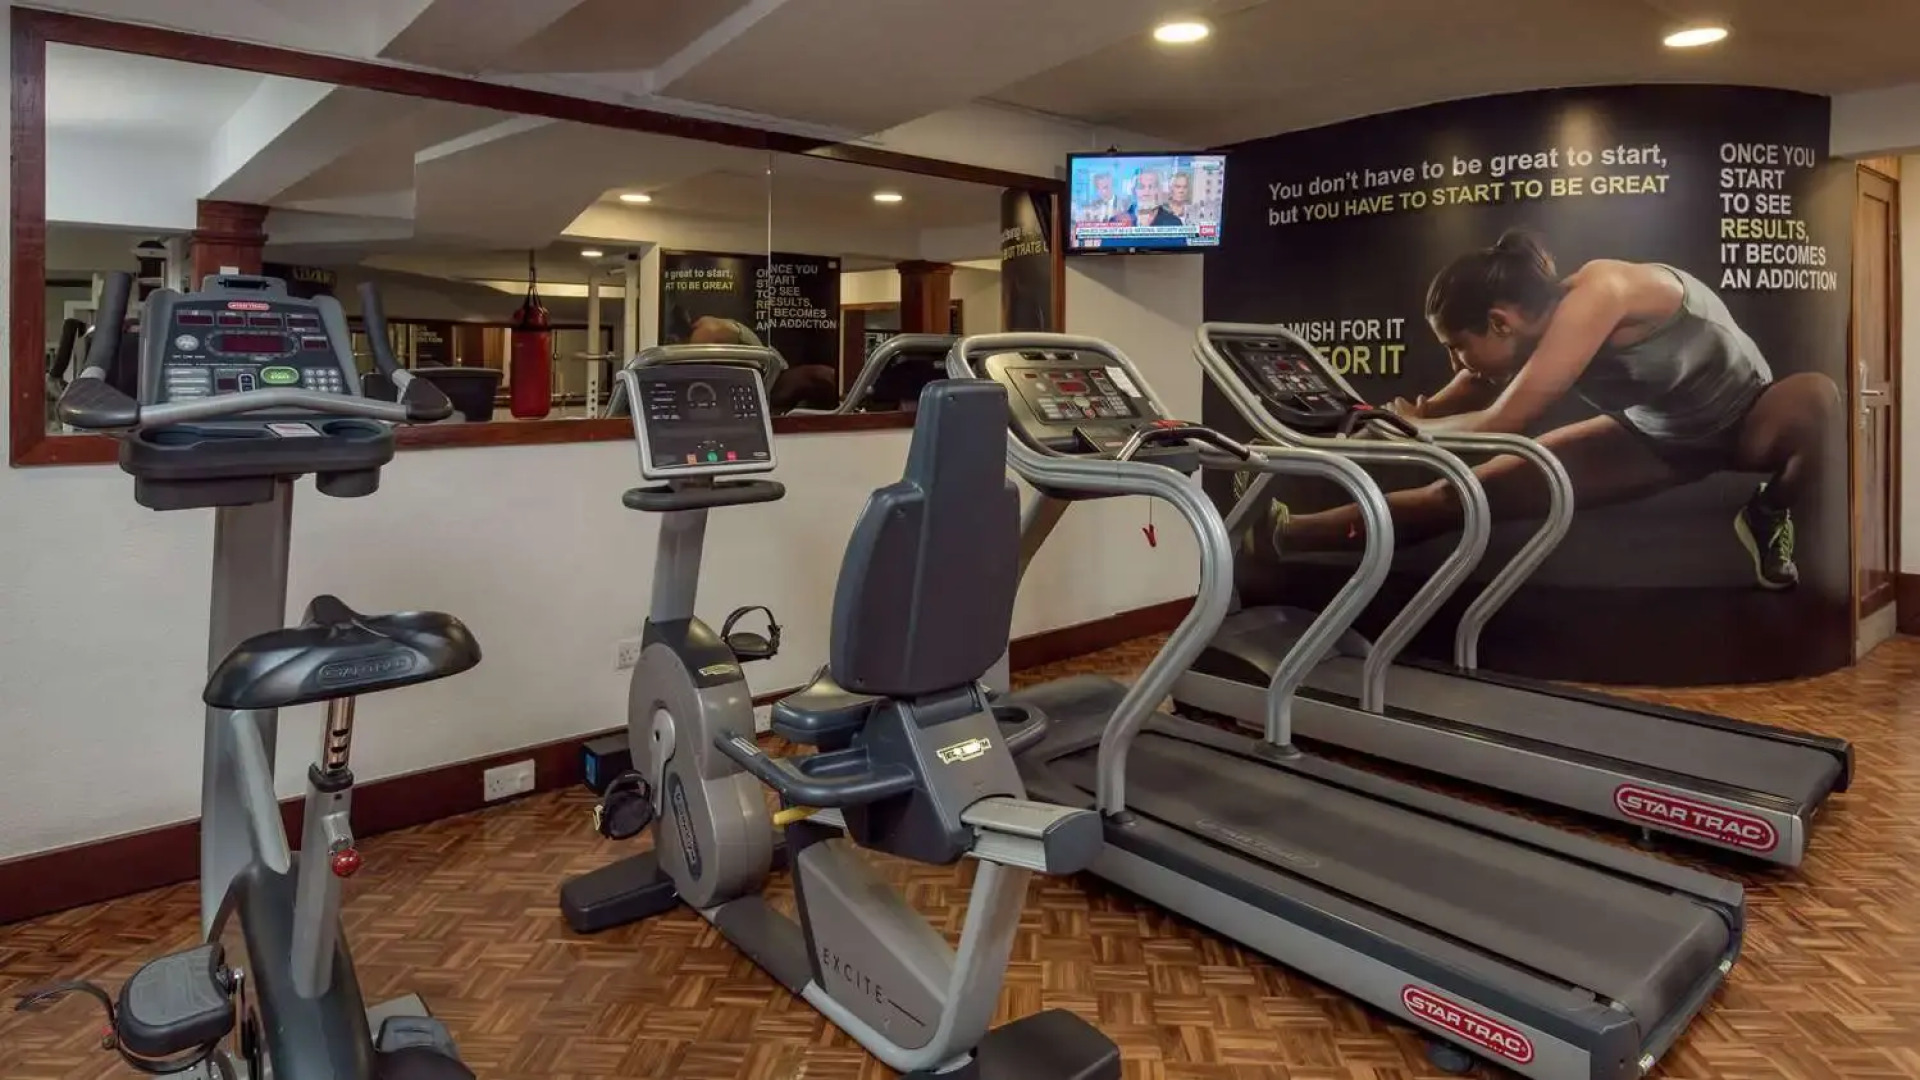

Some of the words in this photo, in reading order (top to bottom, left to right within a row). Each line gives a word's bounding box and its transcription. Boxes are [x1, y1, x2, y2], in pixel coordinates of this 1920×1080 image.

[1720, 143, 1778, 164] ONCE
[1783, 145, 1814, 168] YOU
[1269, 182, 1302, 200] You
[1309, 171, 1358, 195] don't
[1364, 167, 1414, 187] have
[1422, 161, 1445, 179] to
[1452, 155, 1482, 176] be
[1491, 147, 1558, 177] great
[1567, 146, 1592, 167] to
[1601, 144, 1667, 168] start,
[1720, 168, 1785, 190] START
[1269, 205, 1298, 226] but
[1303, 202, 1339, 221] YOU
[1345, 195, 1394, 216] HAVE
[1399, 191, 1426, 209] TO
[1432, 183, 1504, 205] START
[1510, 180, 1542, 199] TO
[1551, 177, 1583, 196] BE
[1590, 175, 1670, 195] GREAT
[1720, 193, 1749, 214] TO
[1756, 193, 1791, 214] SEE
[1721, 218, 1809, 243] RESULTS,
[1721, 243, 1741, 264] IT
[1747, 244, 1827, 265] BECOMES
[702, 281, 734, 291] GREAT
[1720, 268, 1751, 288] AN
[1756, 269, 1837, 290] ADDICTION
[780, 286, 800, 296] SEE
[773, 308, 827, 318] BECOMES
[780, 319, 837, 329] ADDICTION
[1340, 319, 1381, 341] FOR
[1387, 318, 1405, 339] IT
[1380, 344, 1405, 374] IT
[1623, 796, 1687, 821] STAR
[1692, 813, 1762, 840] TRAC
[822, 947, 883, 1004] EXCITE
[1408, 996, 1460, 1026] STAR
[1464, 1019, 1521, 1052] TRAC
